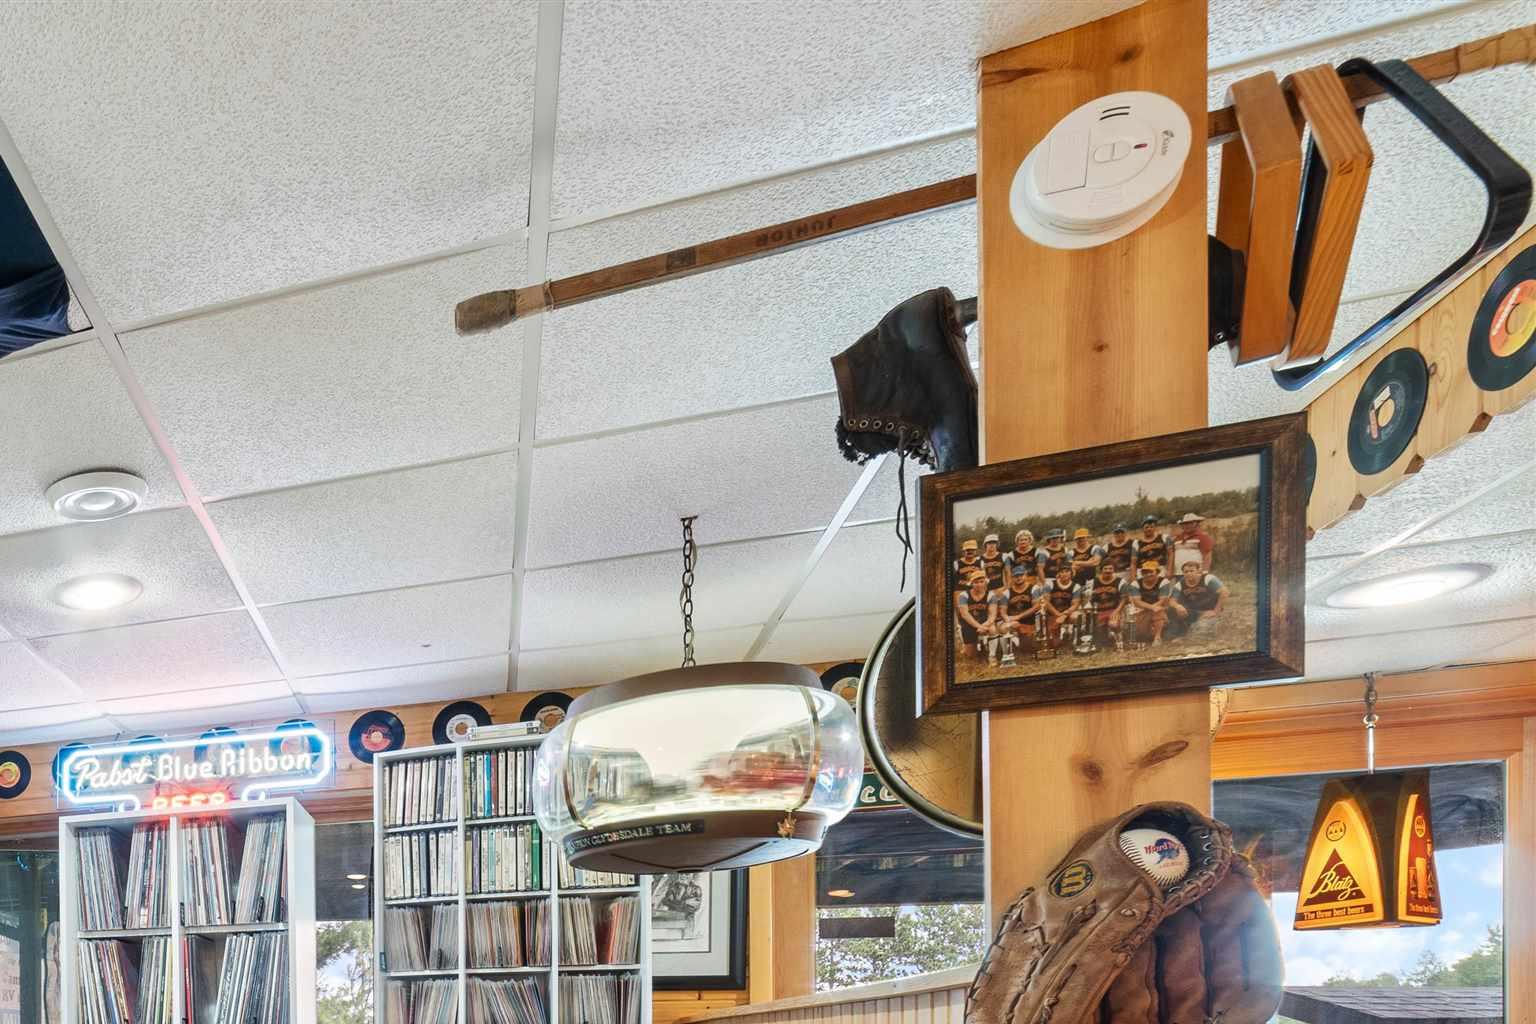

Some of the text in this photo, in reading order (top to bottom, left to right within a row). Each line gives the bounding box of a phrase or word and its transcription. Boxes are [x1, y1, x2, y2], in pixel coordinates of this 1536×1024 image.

[755, 214, 837, 247] JUNIOR
[75, 749, 312, 791] Pabst Blue Ribbon
[655, 823, 693, 835] TEAM
[1310, 861, 1361, 900] Blatz
[1303, 911, 1316, 921] The
